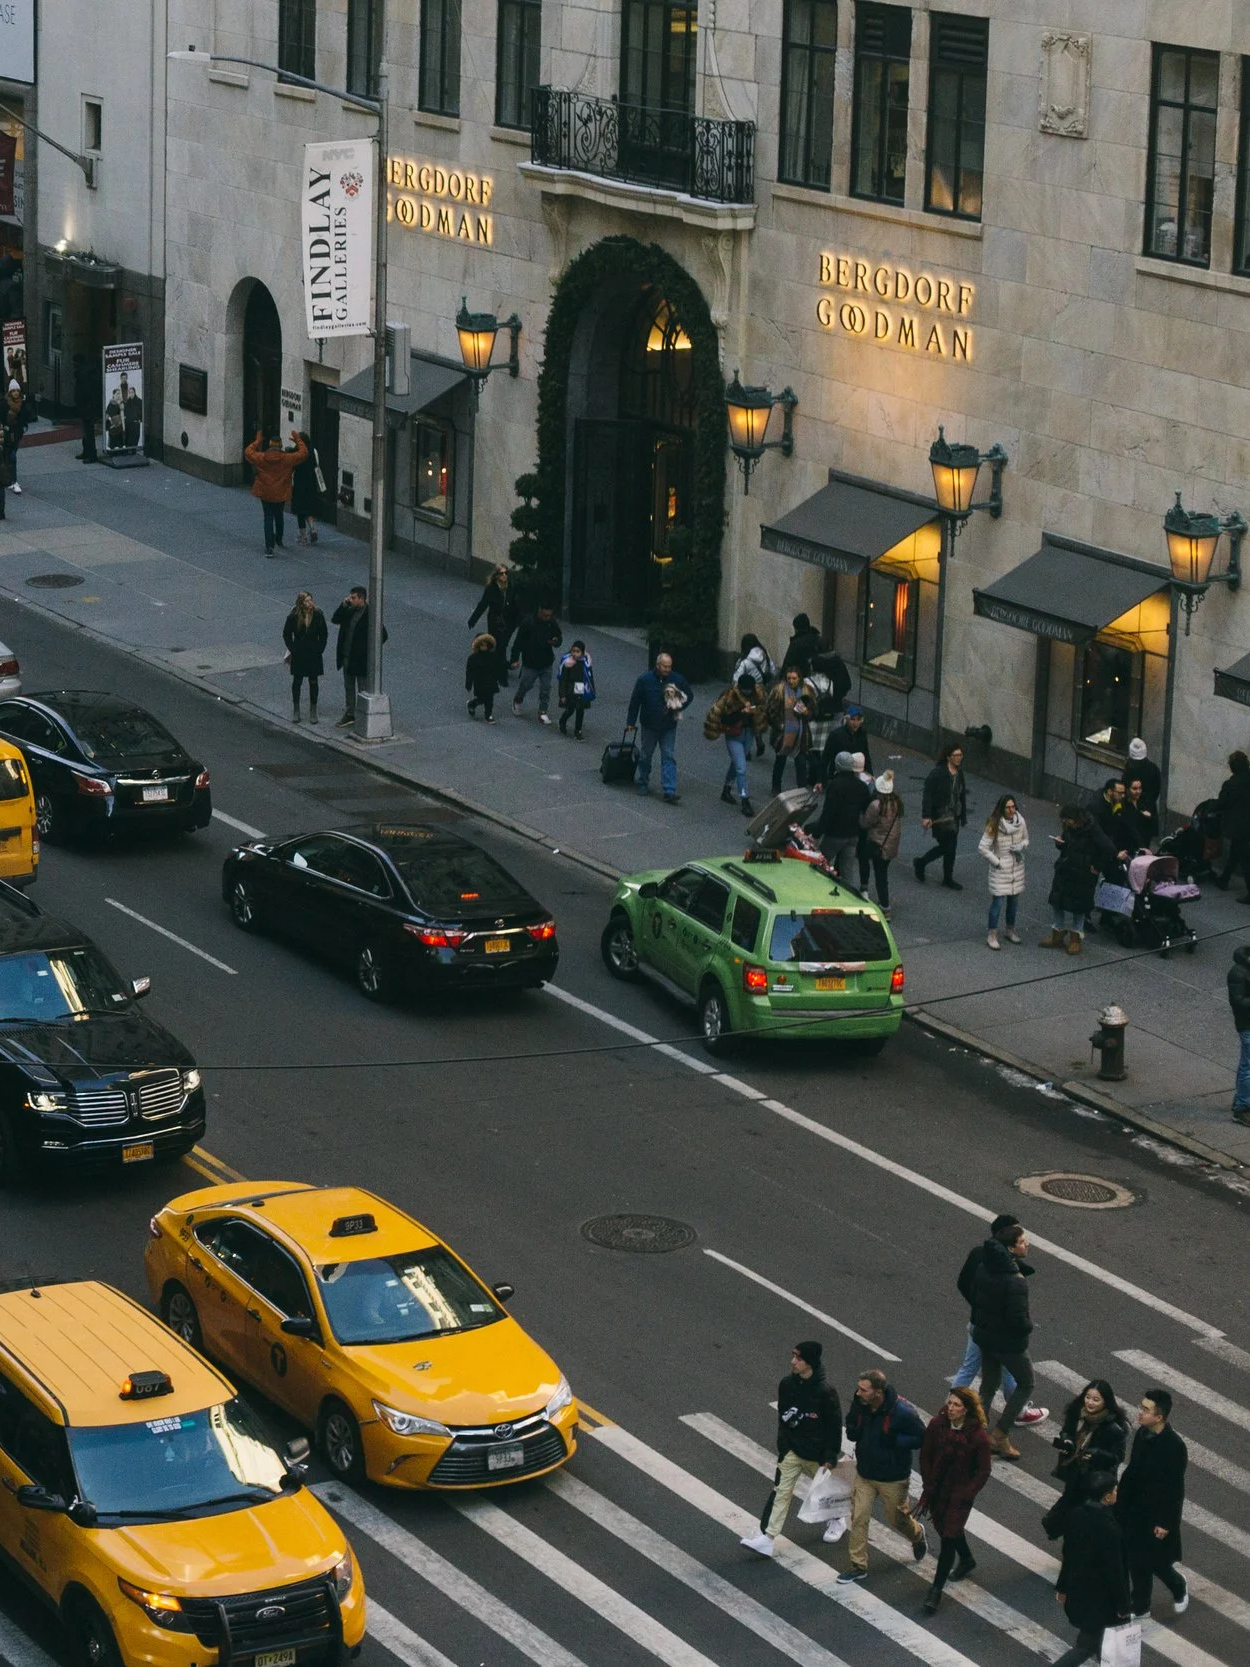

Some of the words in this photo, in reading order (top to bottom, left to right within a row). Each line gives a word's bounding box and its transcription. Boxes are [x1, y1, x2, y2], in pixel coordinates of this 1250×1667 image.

[322, 148, 355, 161] NYC
[390, 160, 490, 204] ERGDORF
[309, 168, 333, 322] FINDLAY
[394, 198, 488, 243] OODMAN
[334, 206, 348, 321] GALLERIES
[819, 254, 973, 314] BERGDORF
[816, 298, 969, 360] GOODMAN
